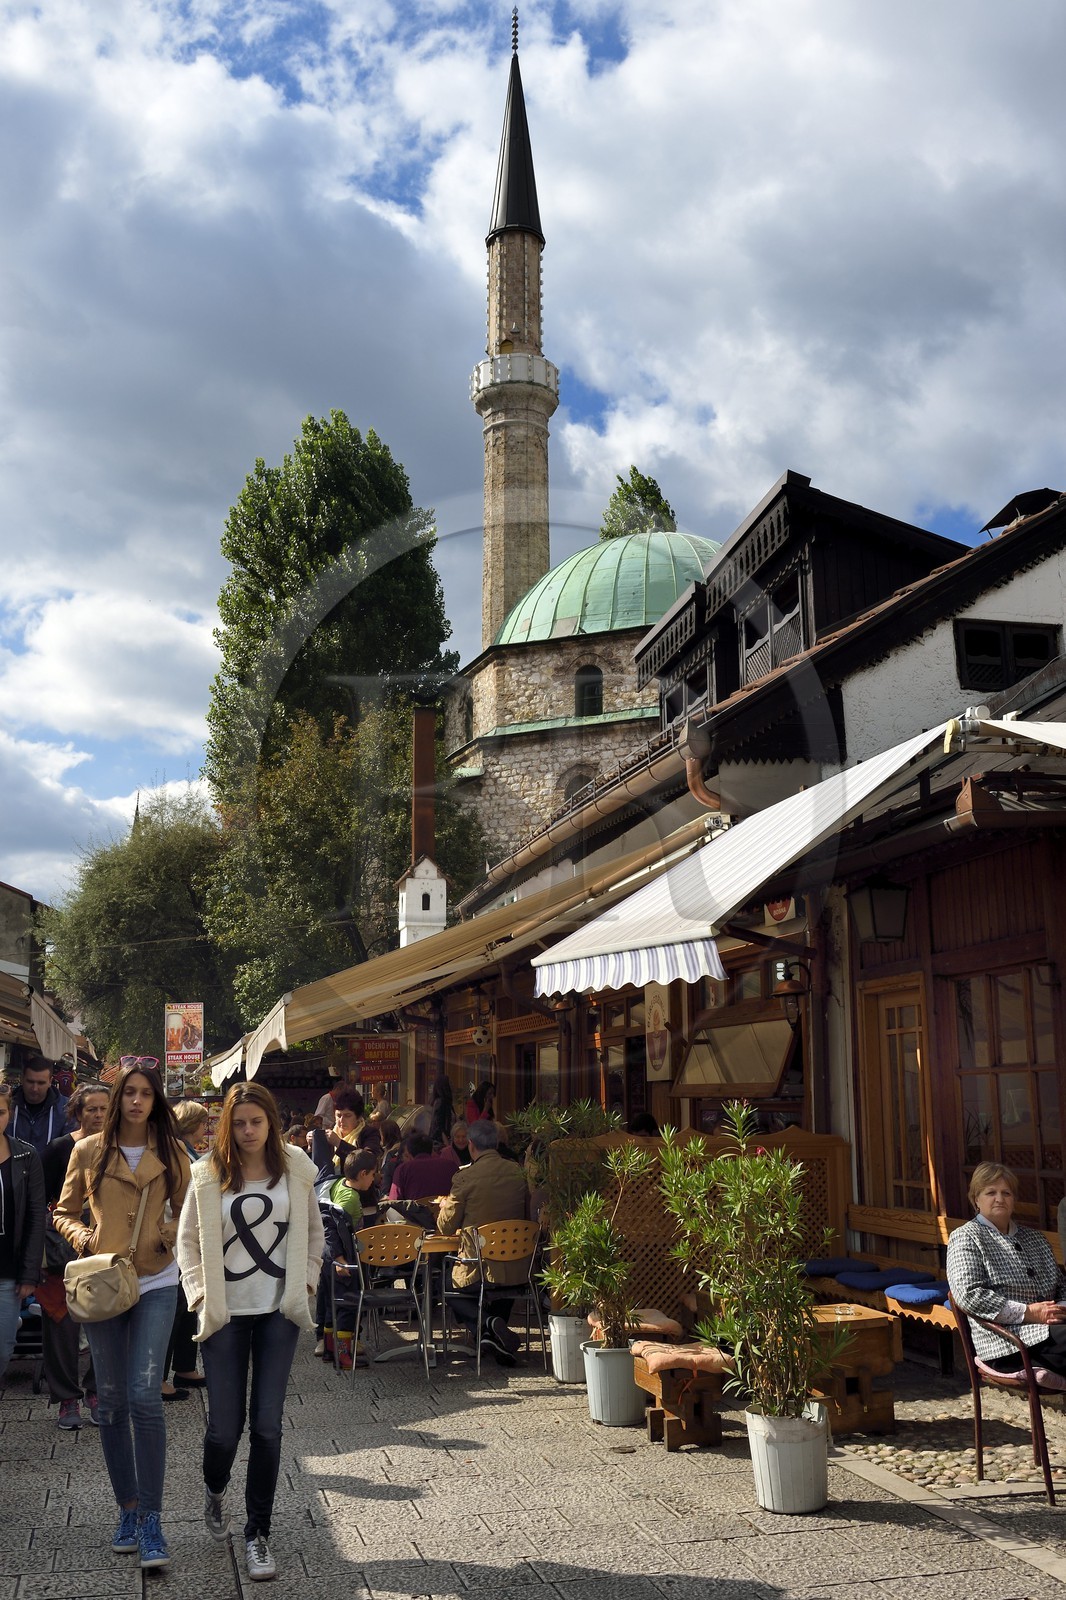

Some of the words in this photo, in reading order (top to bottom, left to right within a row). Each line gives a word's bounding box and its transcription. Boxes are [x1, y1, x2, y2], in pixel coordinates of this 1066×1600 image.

[386, 1041, 399, 1049] PIVO
[364, 1050, 383, 1059] DRAFT
[384, 1050, 399, 1058] BEER
